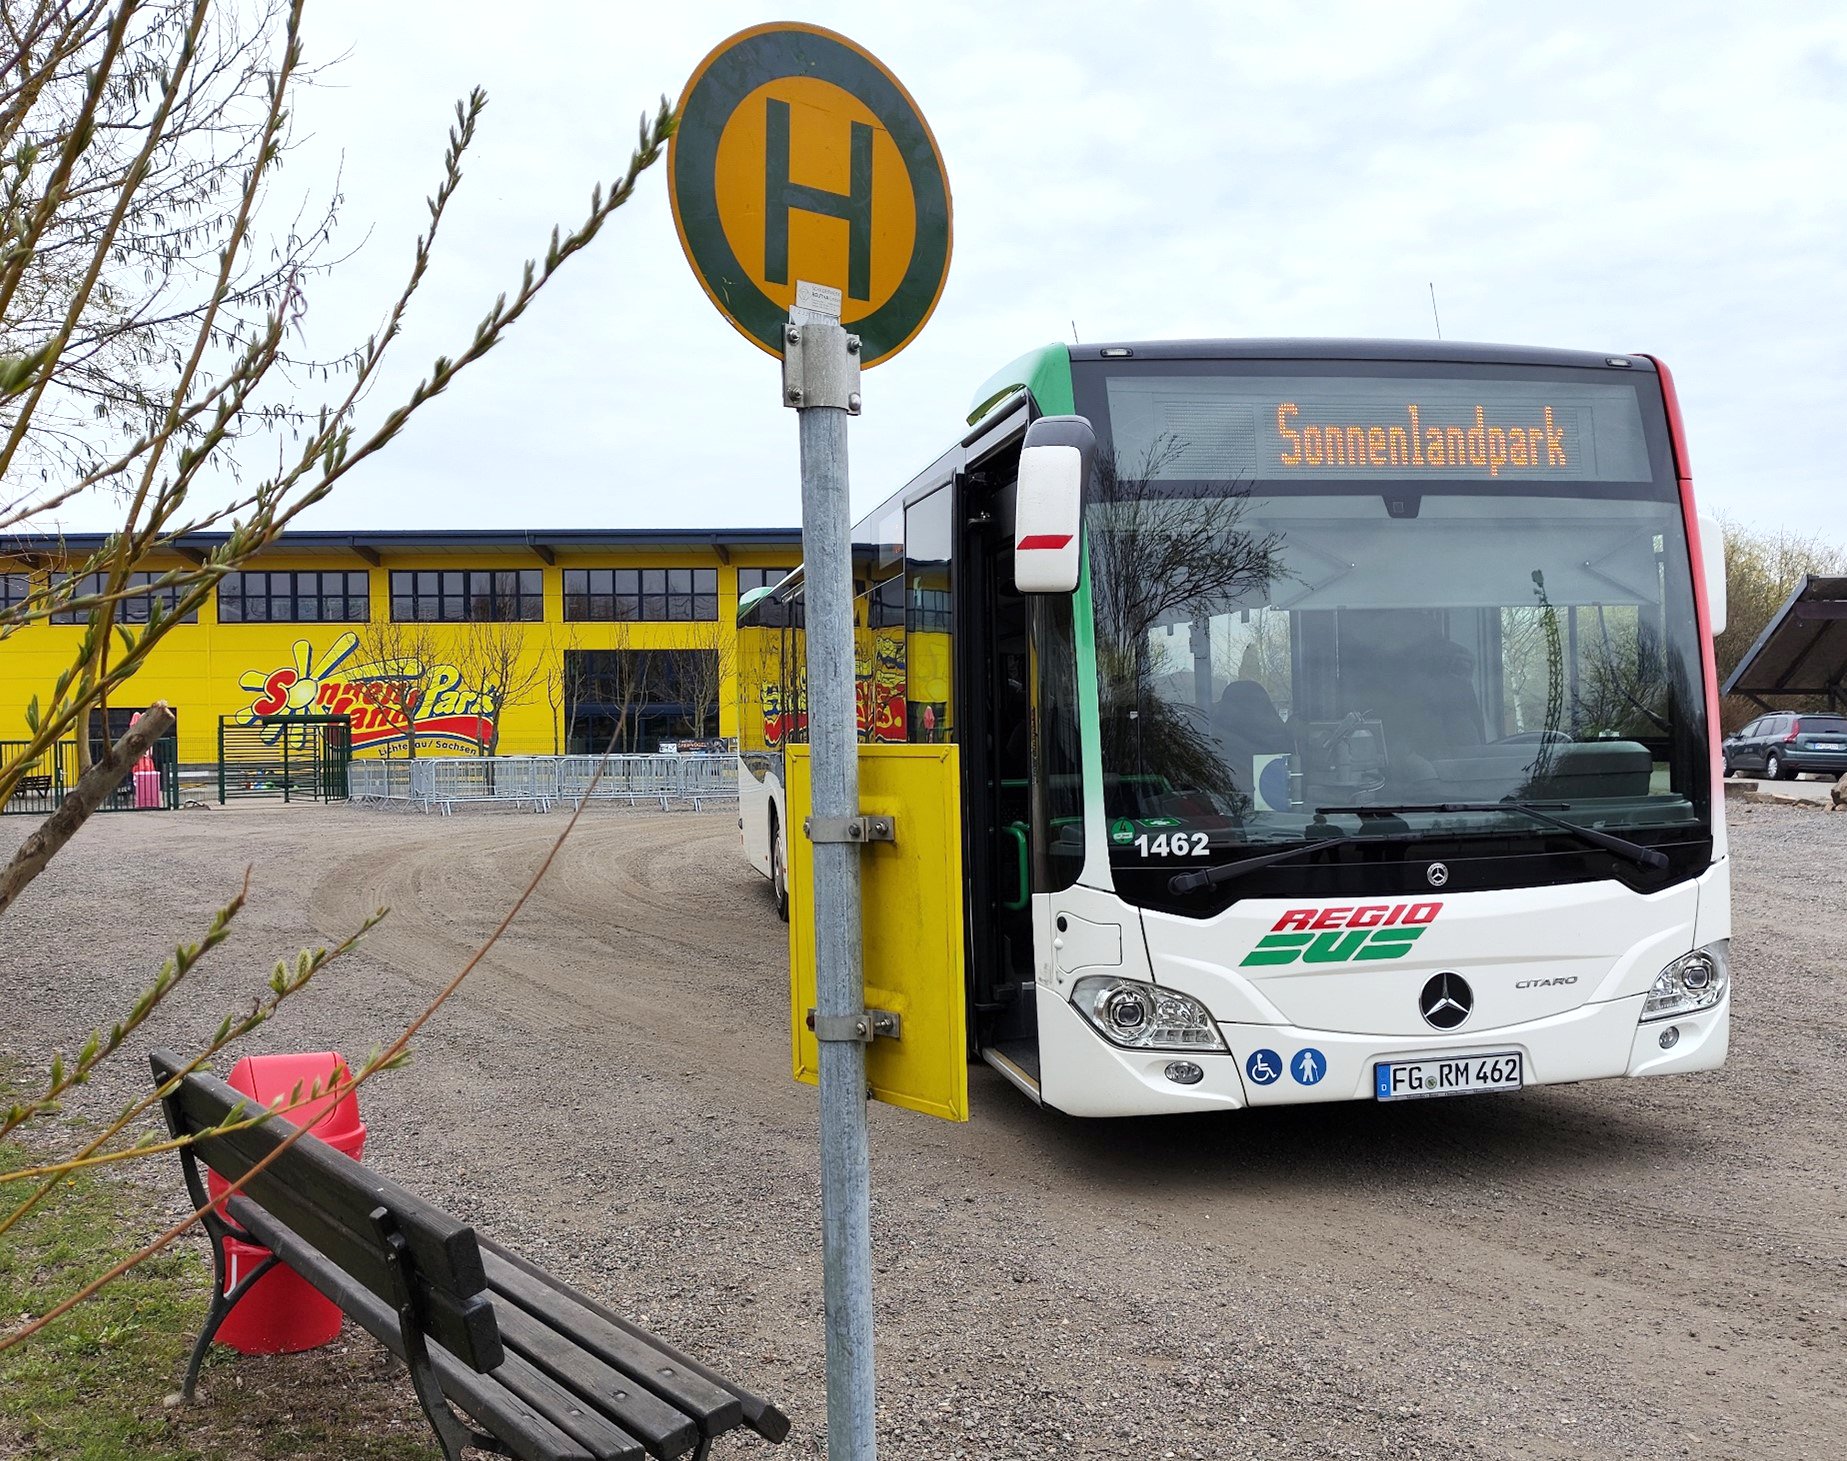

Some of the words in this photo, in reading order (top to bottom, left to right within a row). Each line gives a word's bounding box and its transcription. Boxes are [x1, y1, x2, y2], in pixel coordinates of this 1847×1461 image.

[764, 97, 873, 302] H
[1277, 403, 1567, 477] Sonnenlandpark
[436, 740, 477, 755] Sachsen
[1134, 832, 1210, 857] 1462
[1271, 902, 1444, 932] REGIO
[1239, 927, 1428, 967] BUS
[1515, 976, 1578, 989] CITARO
[1392, 1066, 1423, 1092] FG
[1440, 1062, 1469, 1088] RM
[1476, 1059, 1518, 1084] 462
